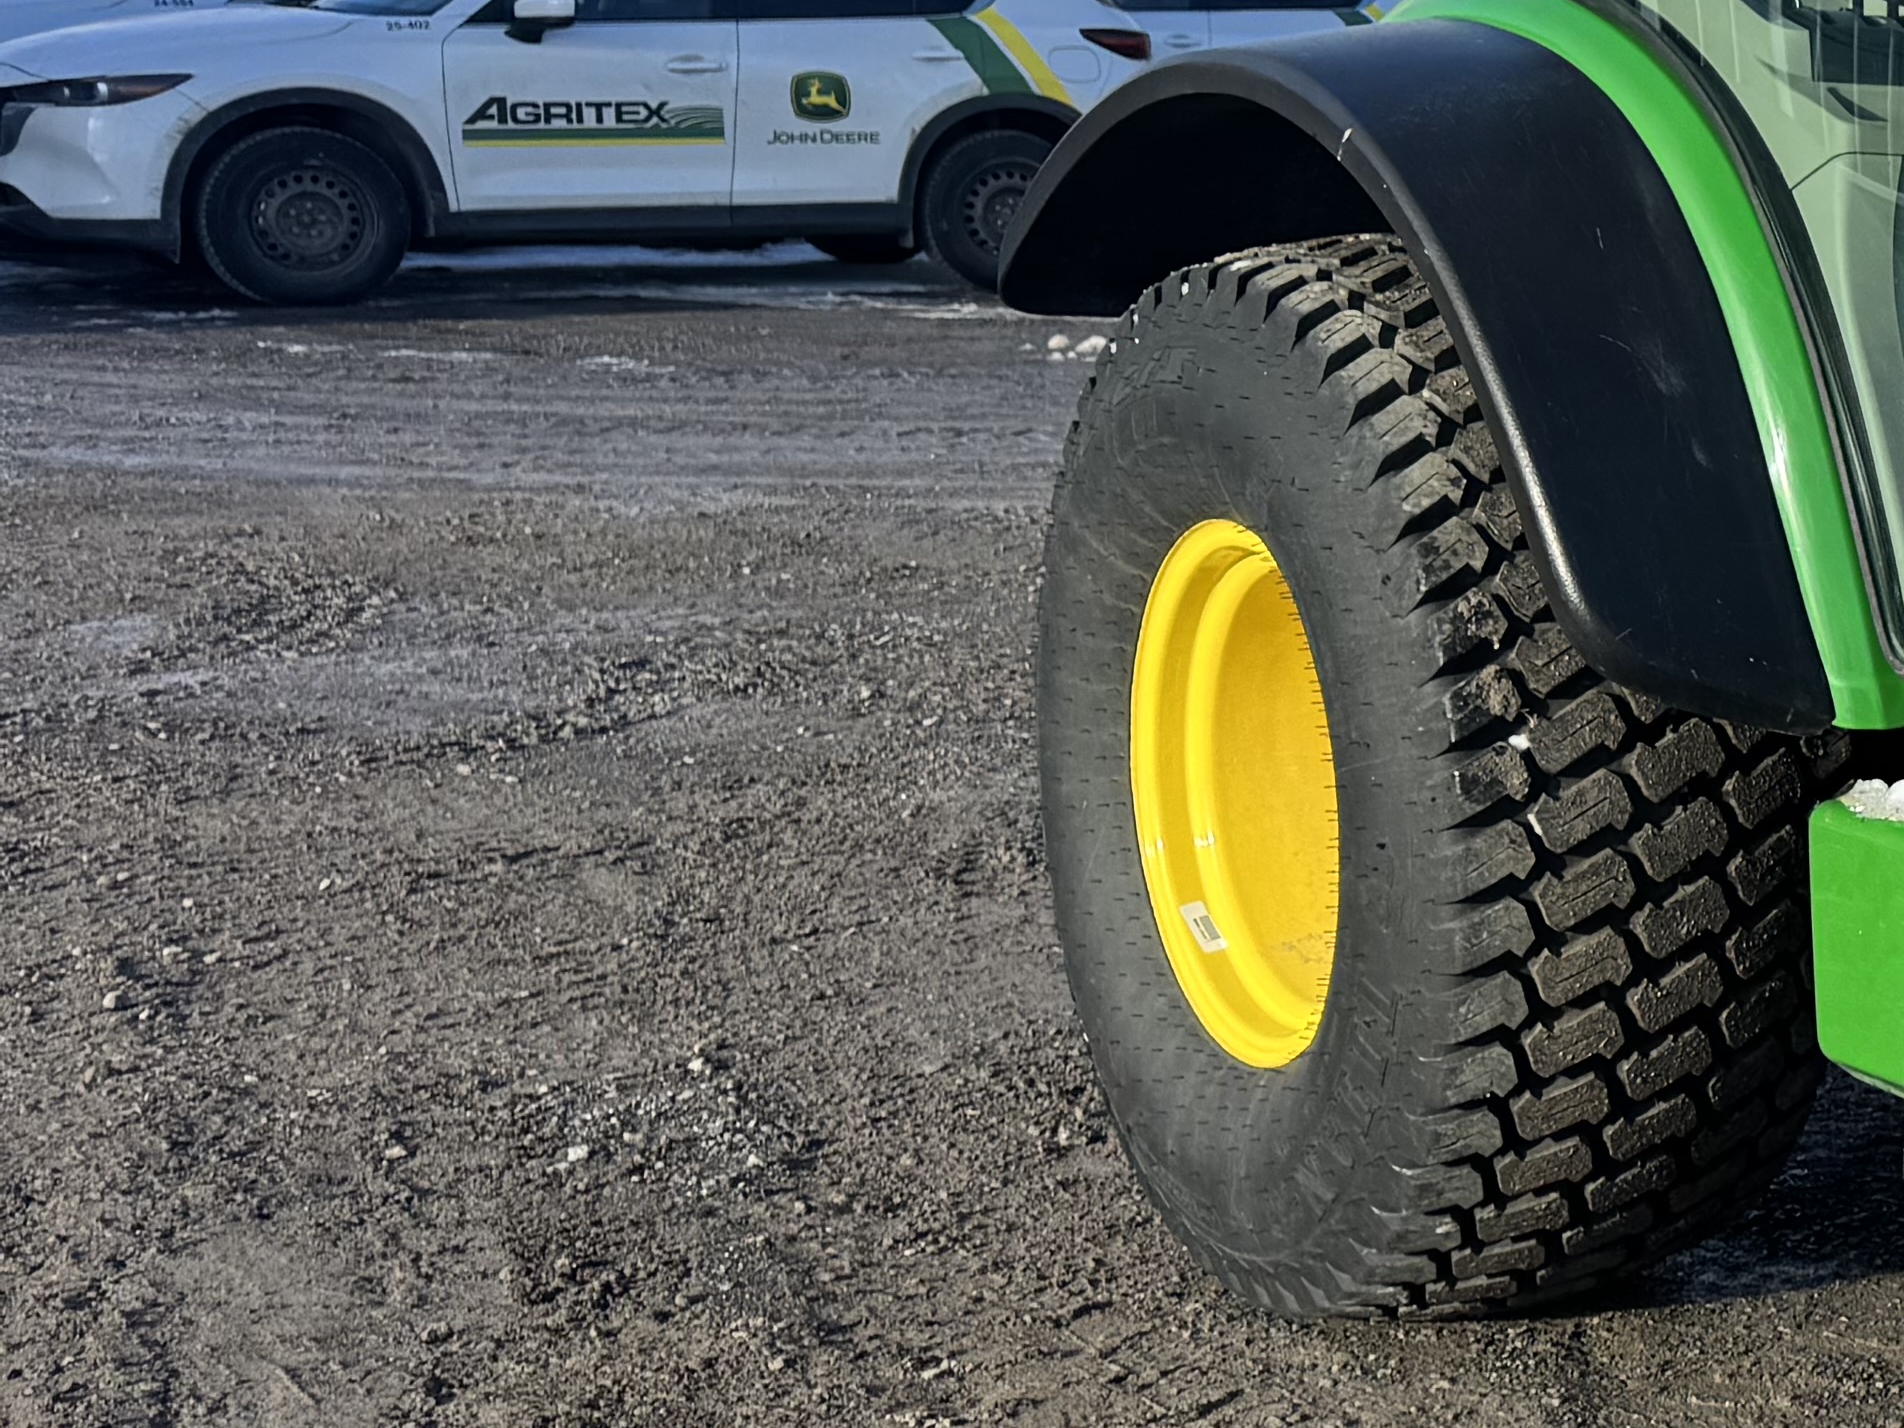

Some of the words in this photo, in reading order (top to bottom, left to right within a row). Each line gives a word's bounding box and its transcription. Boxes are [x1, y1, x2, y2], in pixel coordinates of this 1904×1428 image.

[463, 96, 672, 126] AGRITEX
[767, 130, 817, 145] JOHN
[820, 129, 880, 145] DEERE
